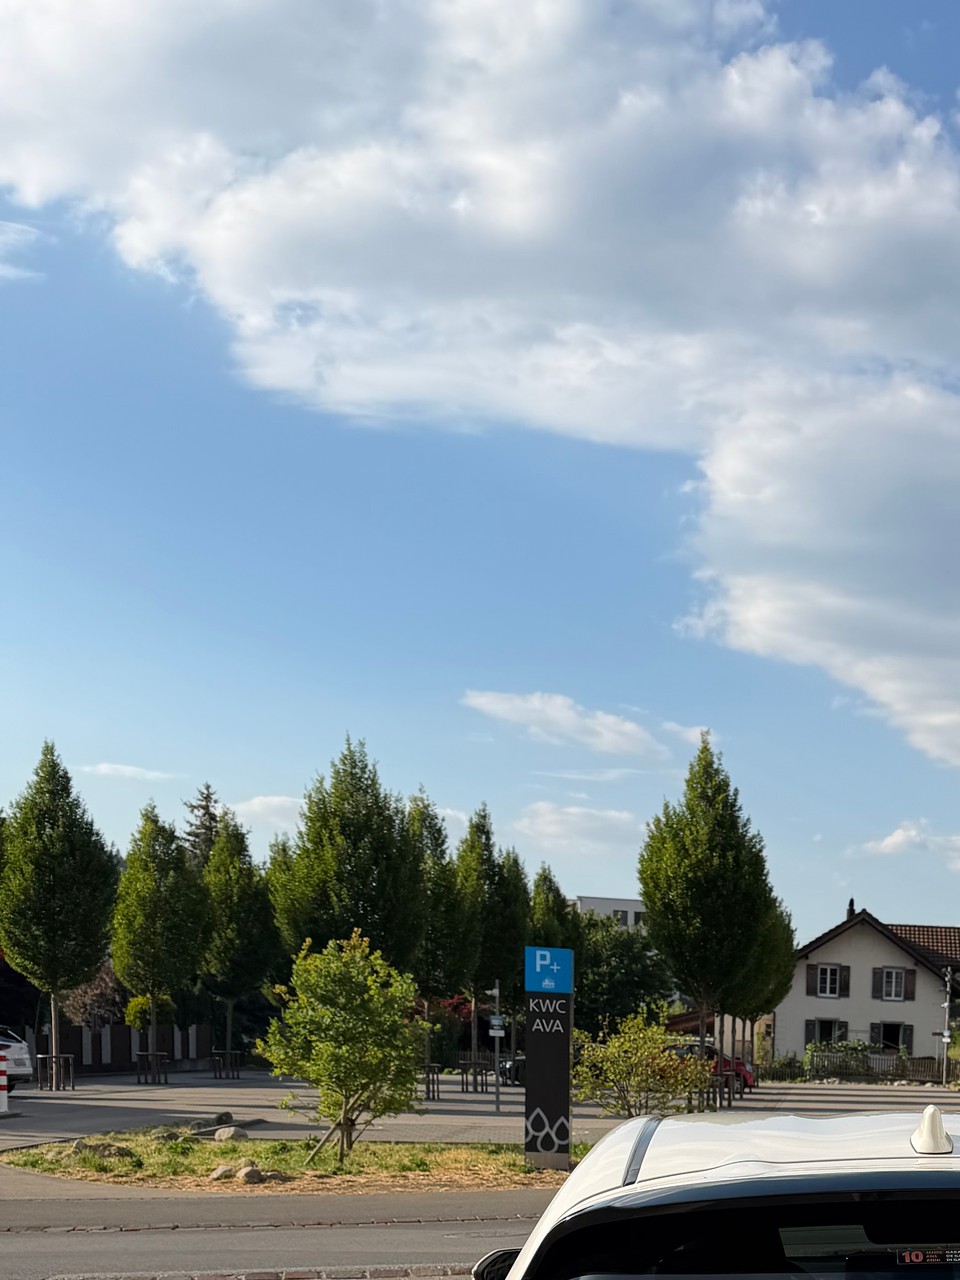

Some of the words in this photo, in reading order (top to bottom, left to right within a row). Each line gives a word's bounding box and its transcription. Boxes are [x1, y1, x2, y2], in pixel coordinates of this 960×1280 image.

[529, 998, 567, 1014] KWC
[532, 1018, 564, 1033] AVA
[901, 1250, 924, 1263] 10
